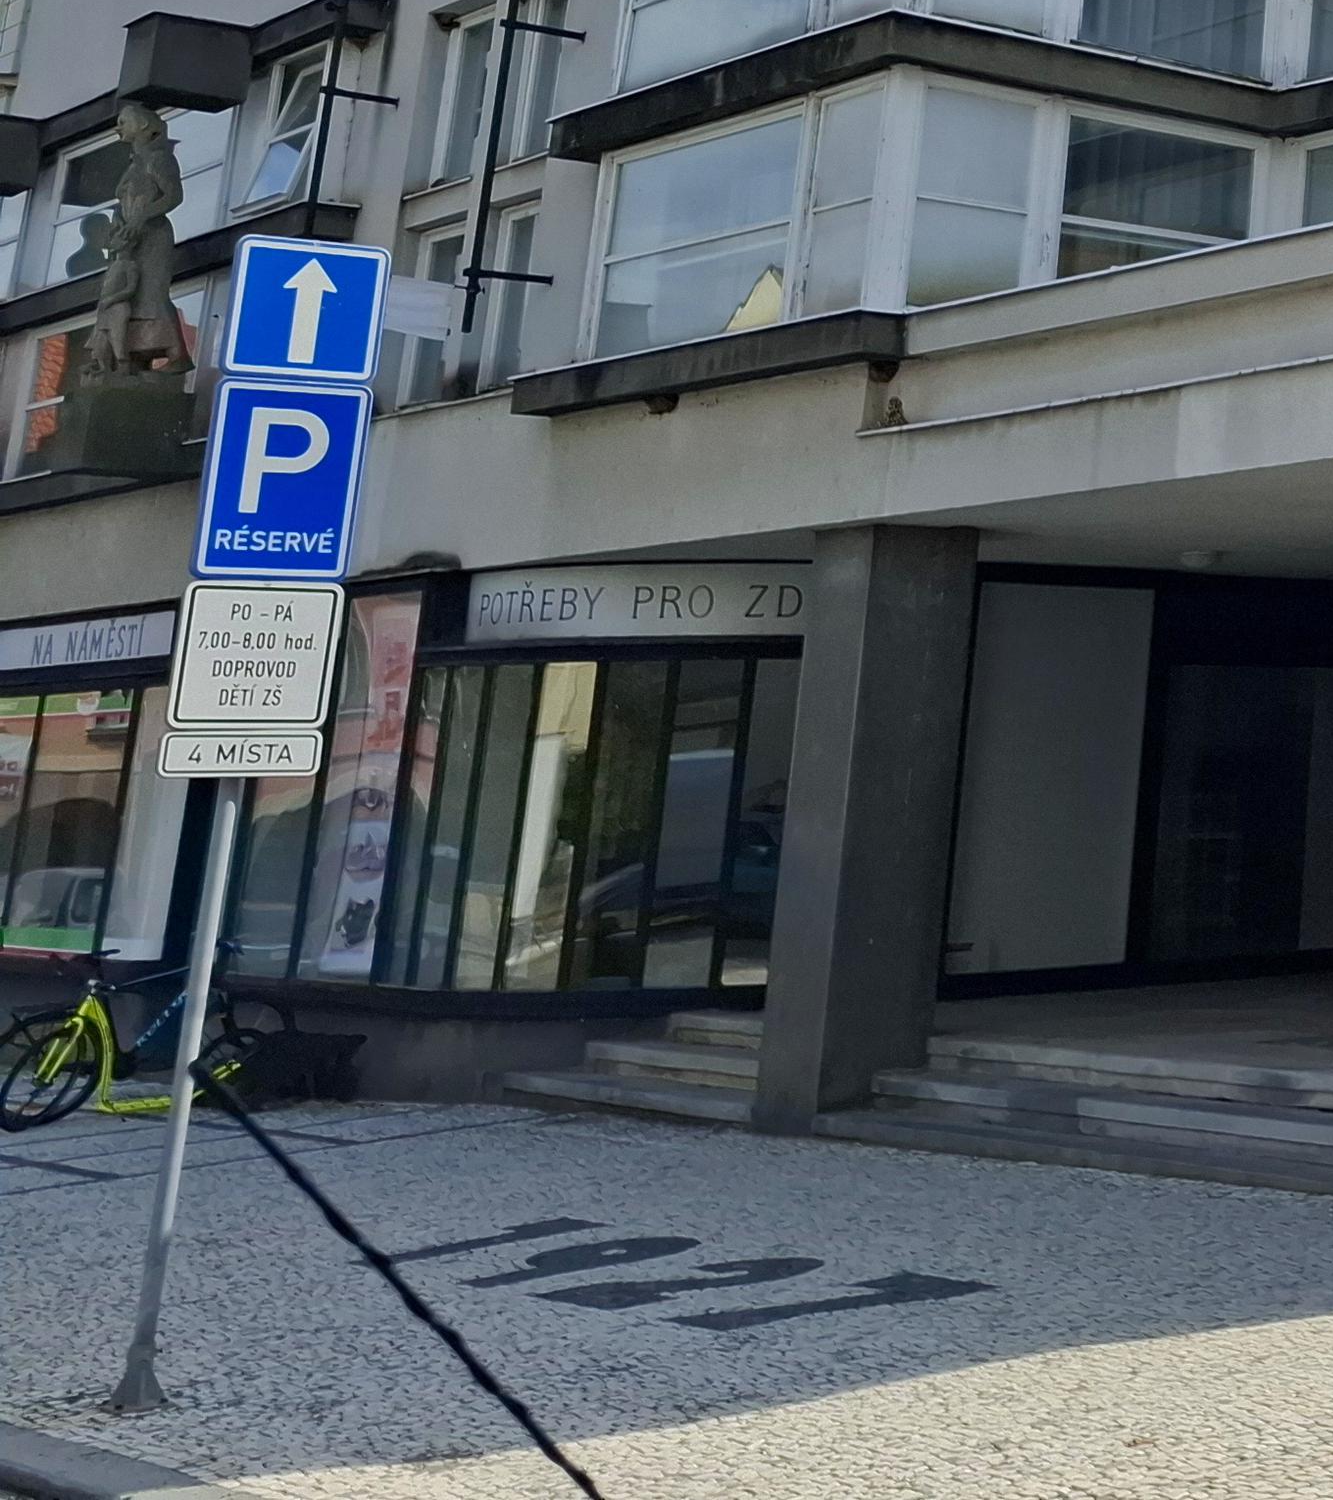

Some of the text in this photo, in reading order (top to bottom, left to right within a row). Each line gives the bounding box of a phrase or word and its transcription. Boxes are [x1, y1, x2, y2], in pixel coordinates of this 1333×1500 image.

[238, 406, 330, 514] P
[214, 524, 335, 554] RÉSERVÉ
[230, 603, 252, 621] PO
[273, 601, 294, 622] PÁ
[478, 581, 605, 627] POTŘEBY
[631, 584, 715, 619] PRO
[31, 616, 146, 666] NA NÁMĚSTÍ
[284, 633, 317, 650] hod.
[212, 660, 297, 678] DOPROVOD
[218, 683, 283, 706] DĚTÍ ZŠ
[188, 739, 293, 764] 4 MÍSTA
